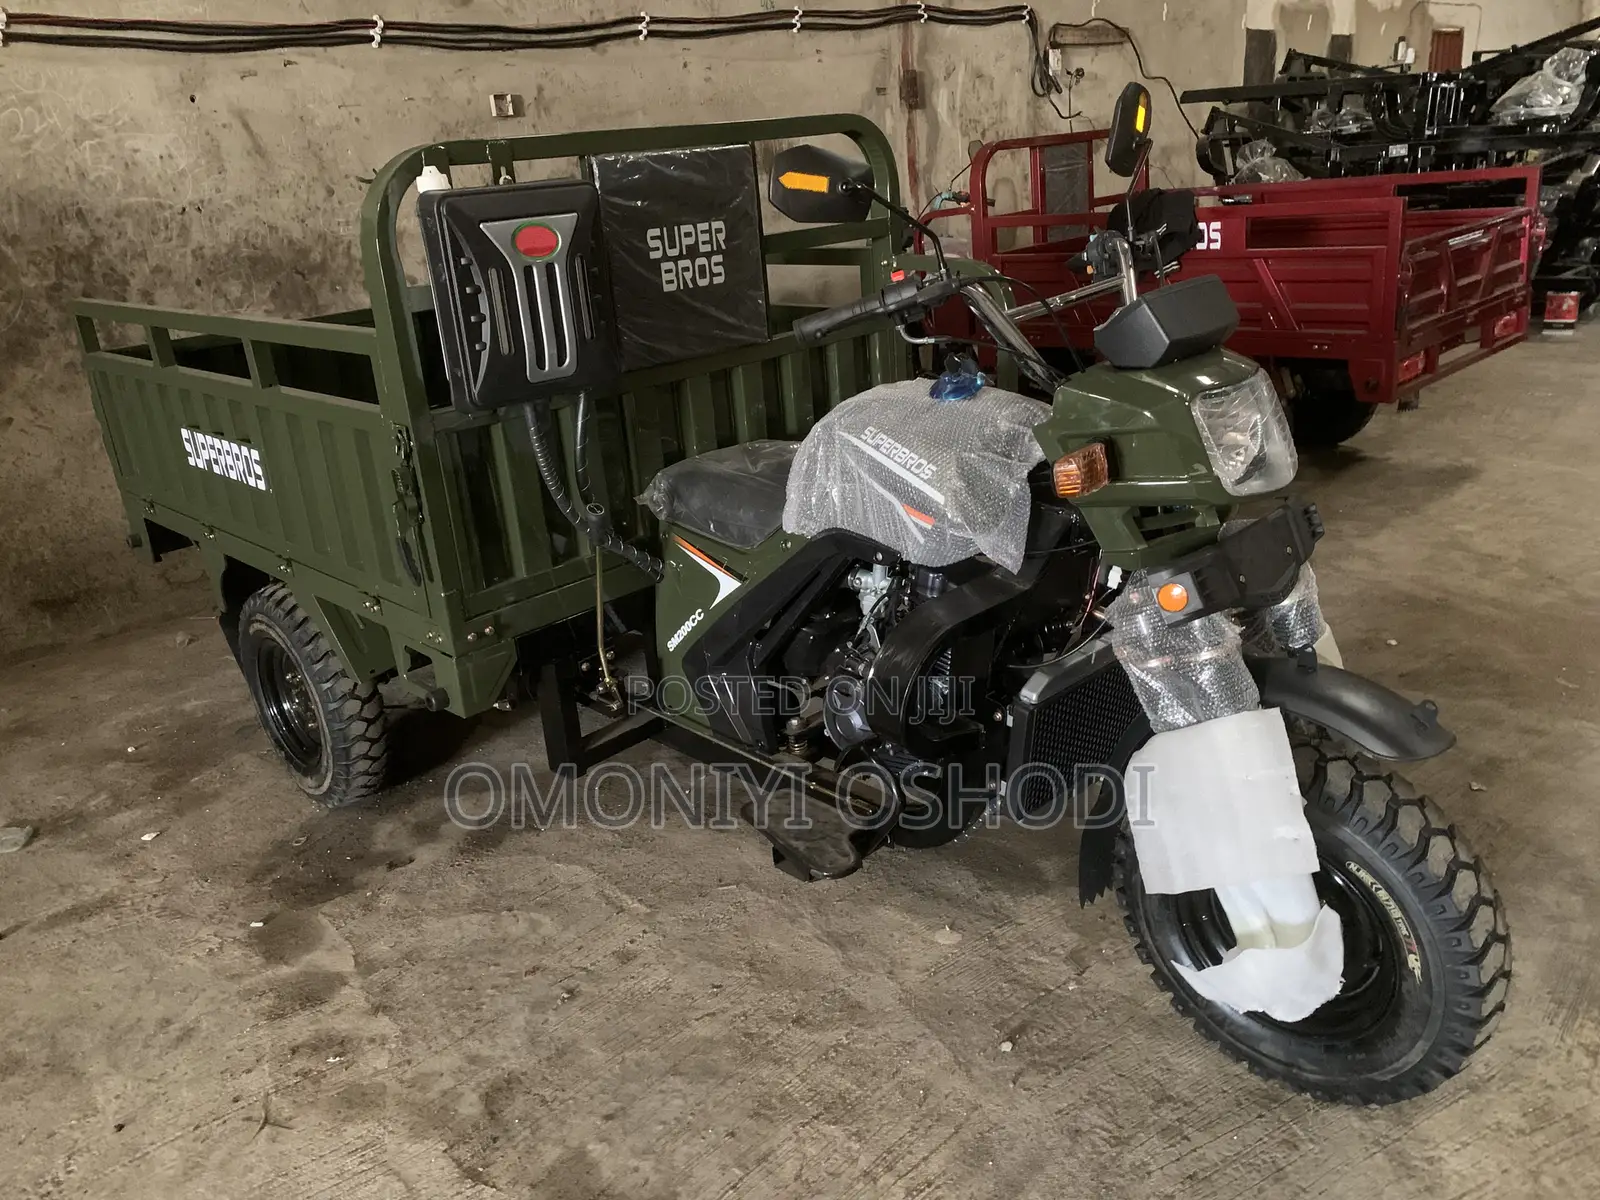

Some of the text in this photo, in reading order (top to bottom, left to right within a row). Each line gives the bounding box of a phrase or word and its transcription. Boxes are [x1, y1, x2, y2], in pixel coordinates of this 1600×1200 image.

[646, 220, 727, 260] SUPER
[660, 254, 726, 293] BROS
[180, 427, 267, 491] SUPERBROS
[859, 425, 938, 480] SUPERBROS
[666, 608, 705, 652] SM200CC
